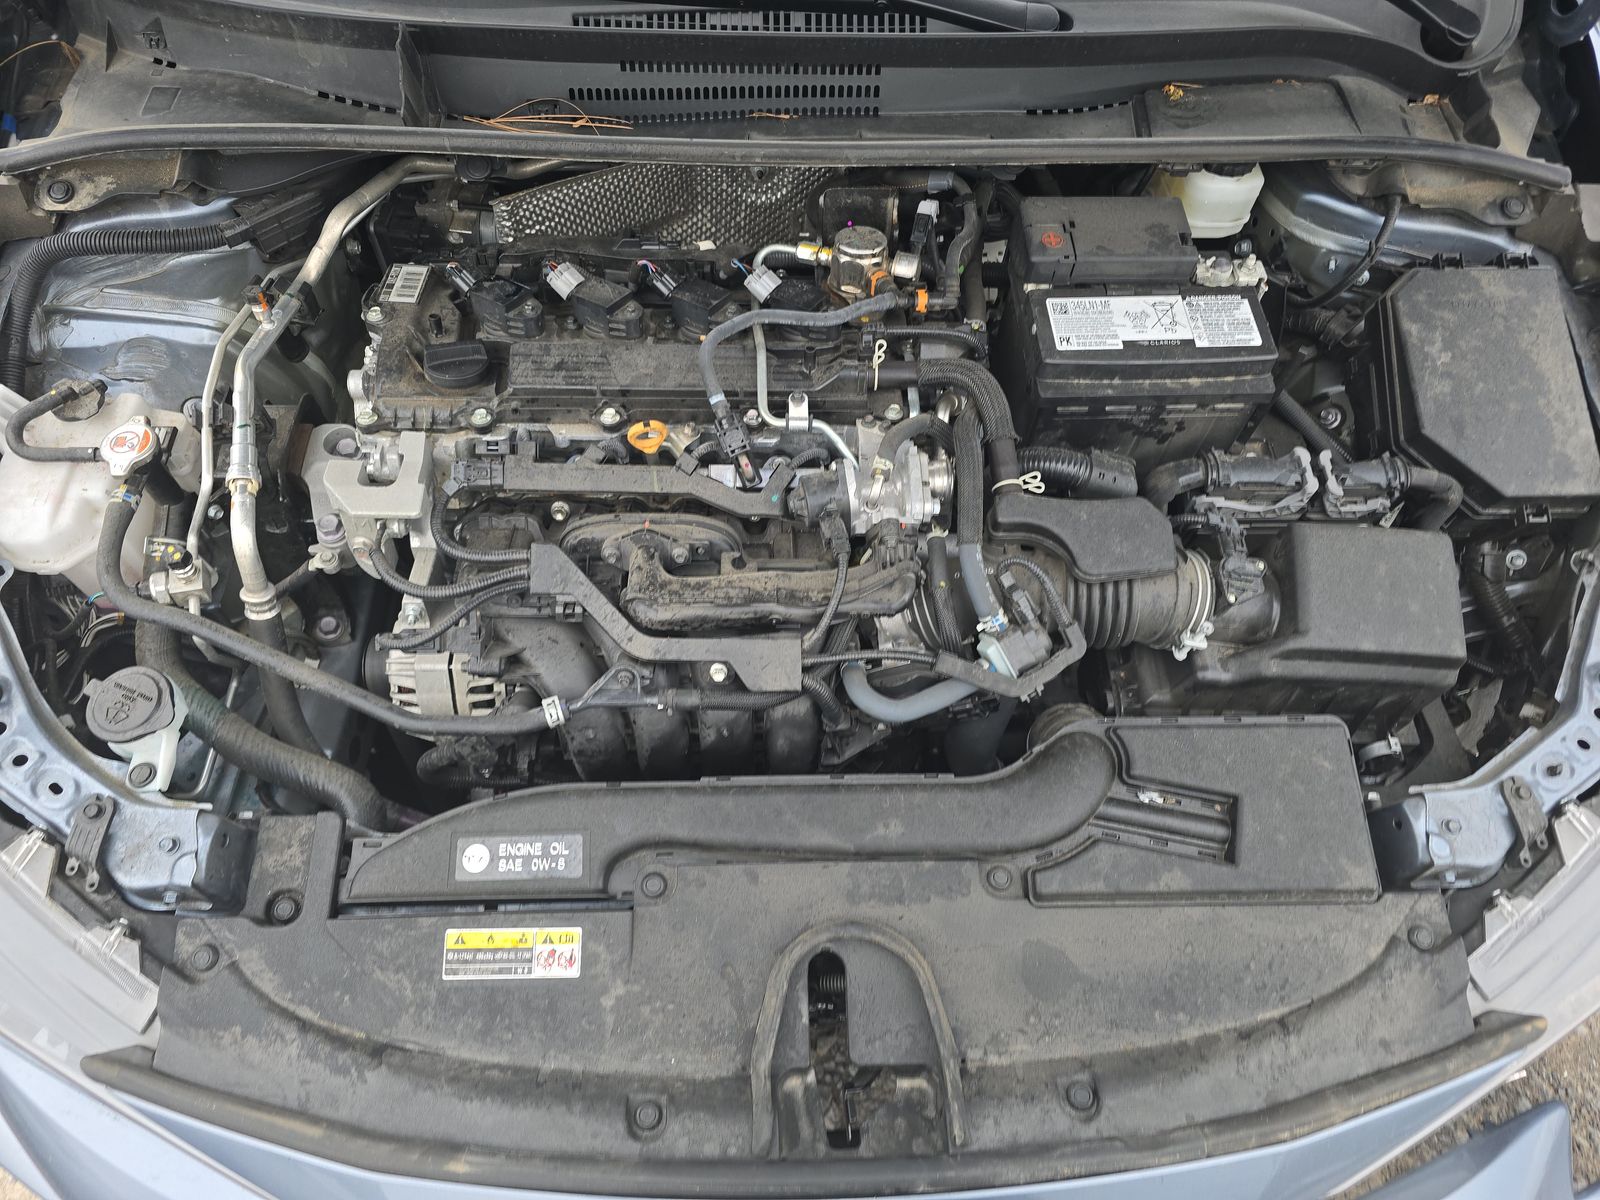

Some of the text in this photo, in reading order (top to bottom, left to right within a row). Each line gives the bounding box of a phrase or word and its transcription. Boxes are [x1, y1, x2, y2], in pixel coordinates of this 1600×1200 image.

[1058, 336, 1073, 347] PK
[498, 841, 569, 857] ENGINE OIL
[498, 858, 523, 872] SAE
